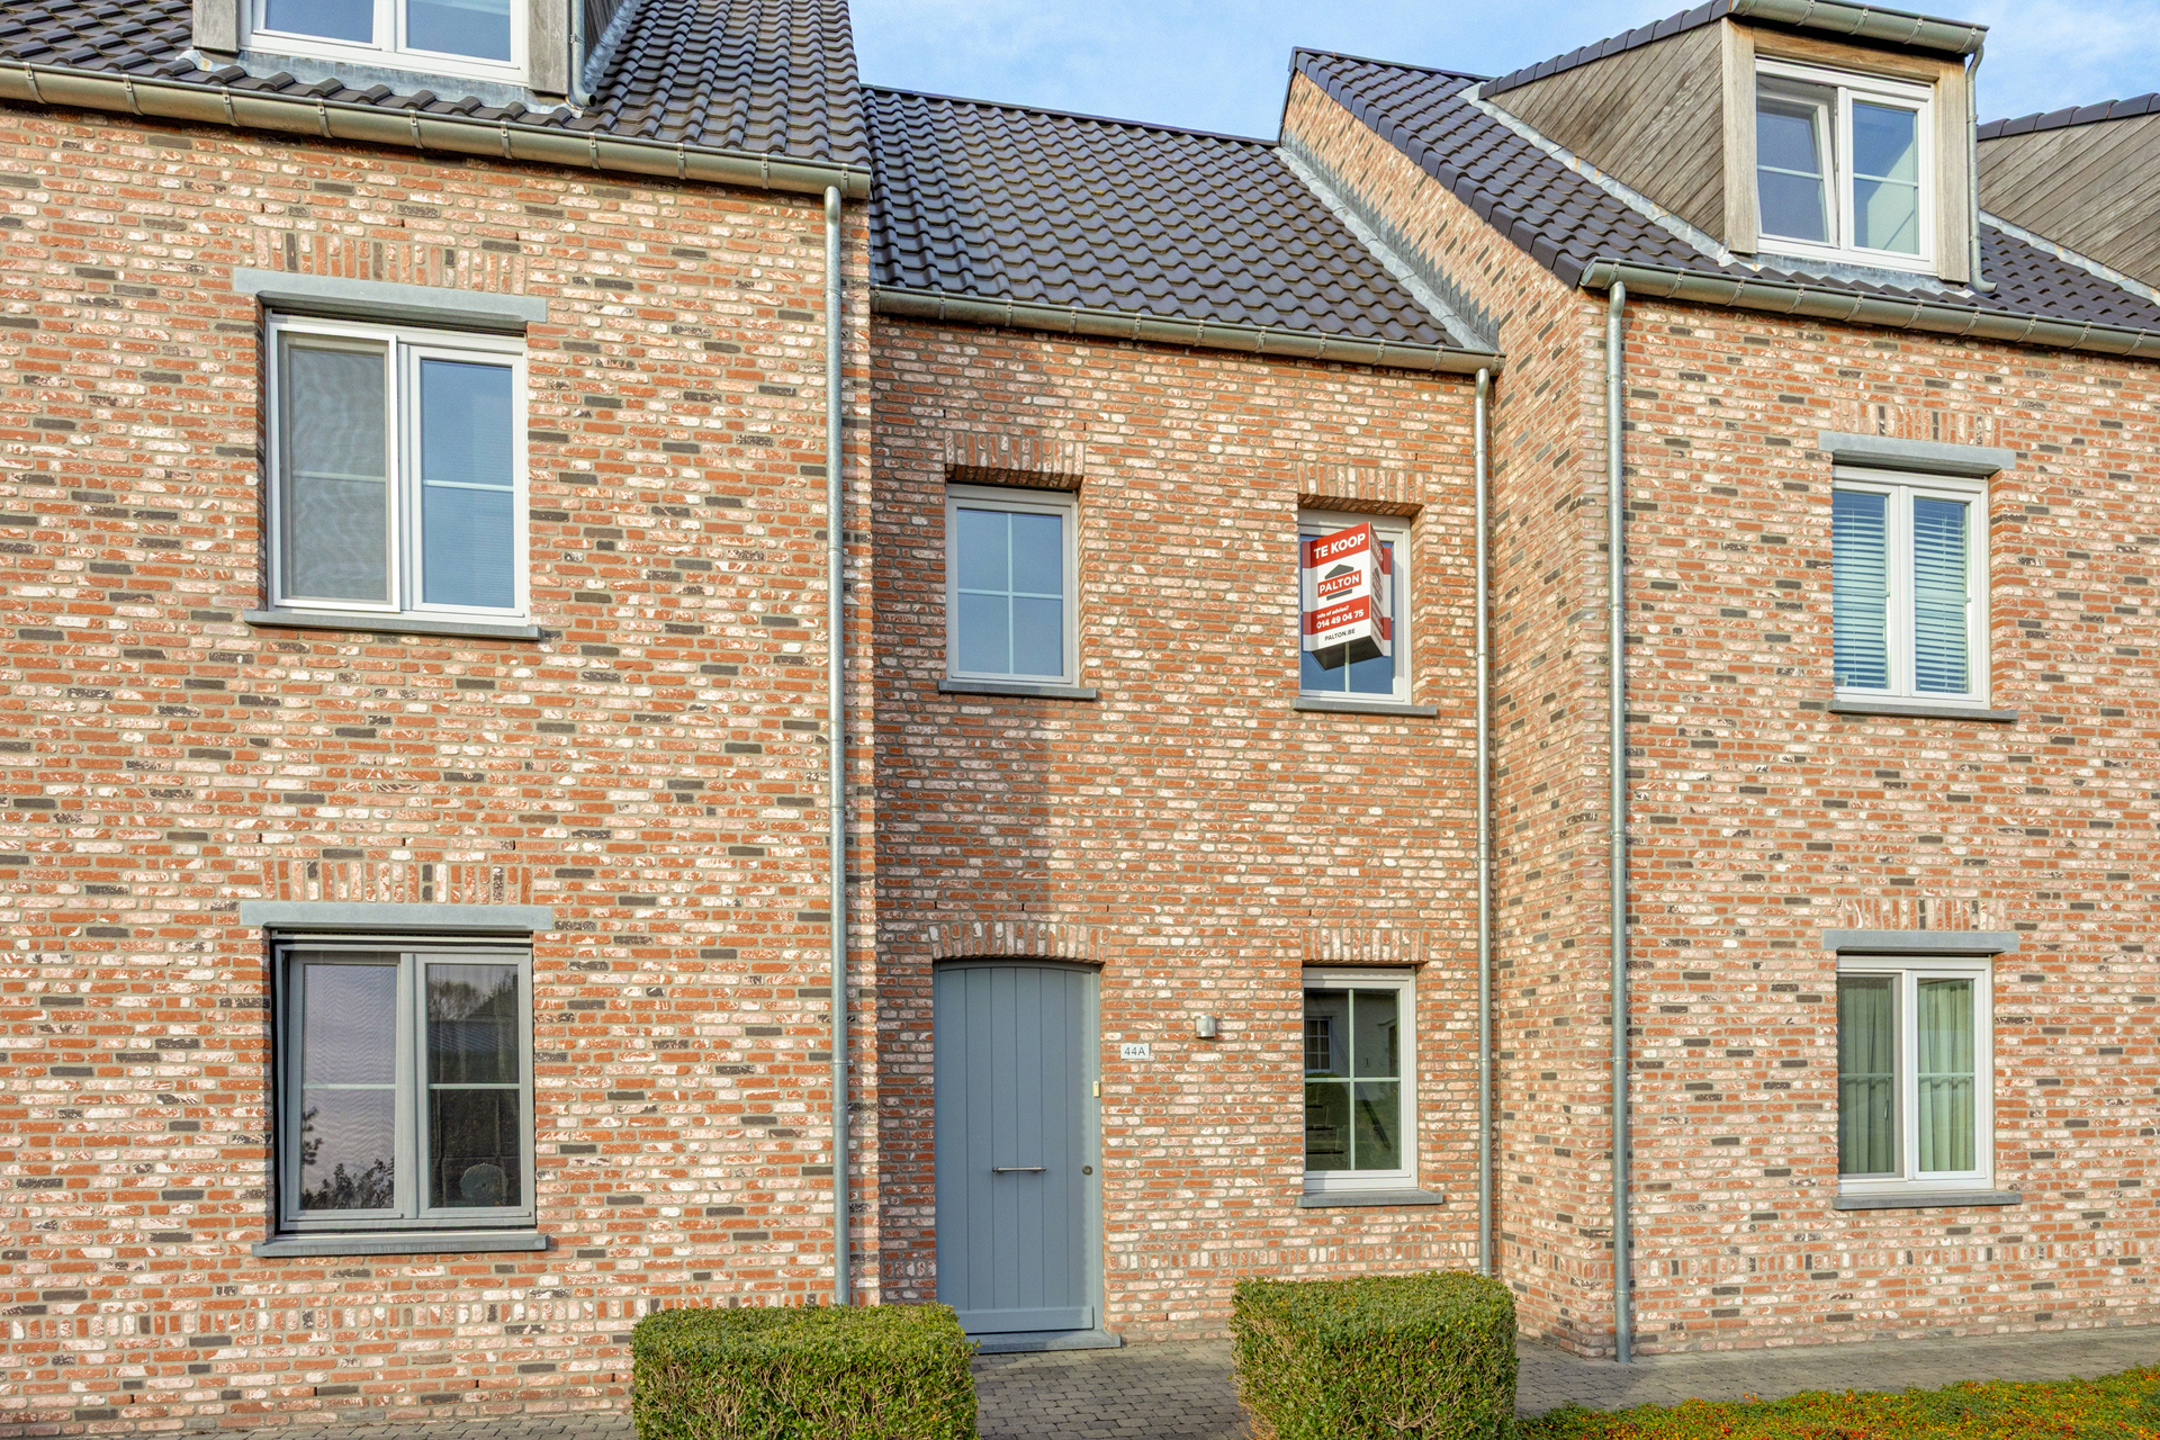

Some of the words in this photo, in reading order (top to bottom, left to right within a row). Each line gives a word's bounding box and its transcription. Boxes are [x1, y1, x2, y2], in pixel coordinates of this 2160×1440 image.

[1314, 545, 1328, 559] TE
[1331, 533, 1366, 554] KOOP
[1319, 573, 1360, 594] PALTON
[1316, 619, 1330, 629] 014
[1330, 615, 1341, 624] 49
[1342, 612, 1353, 622] 04
[1354, 609, 1364, 618] 75
[1124, 1046, 1146, 1056] 44A
